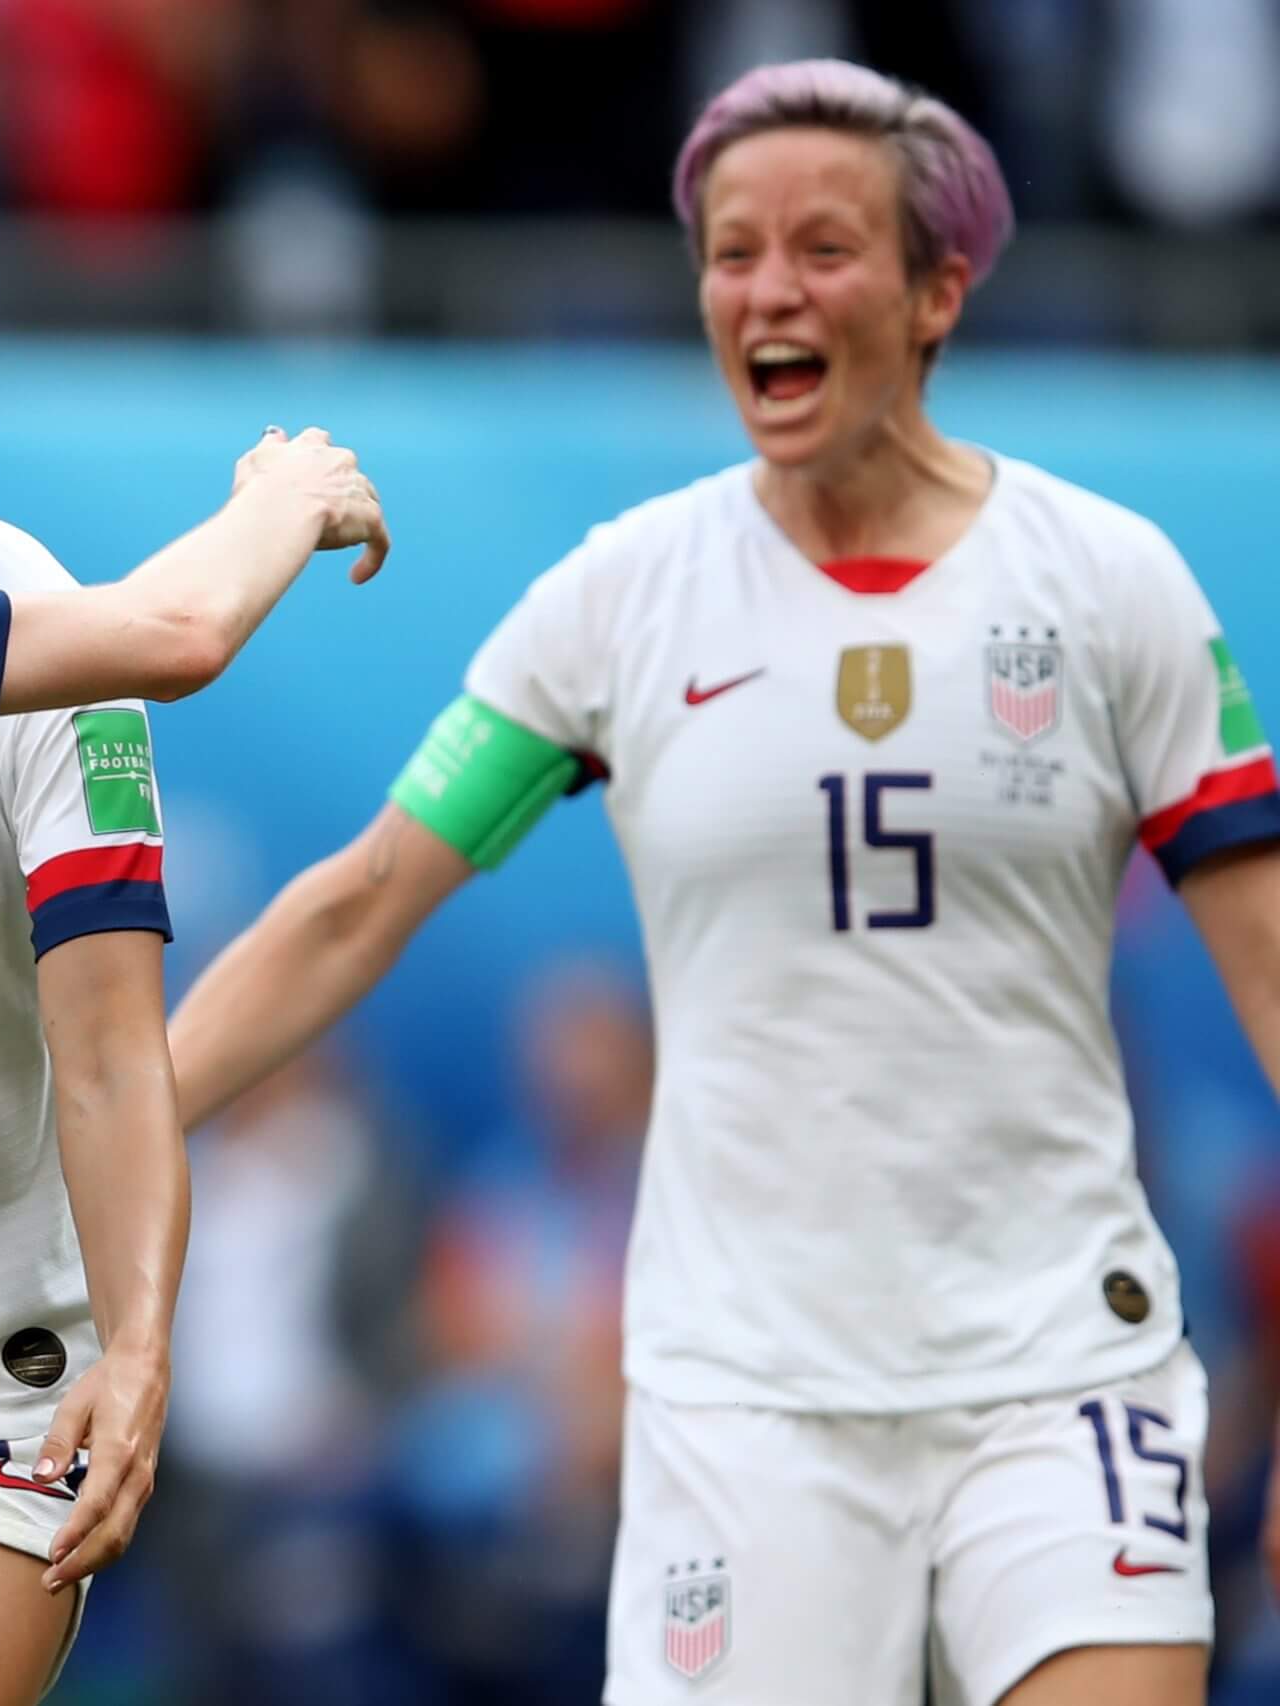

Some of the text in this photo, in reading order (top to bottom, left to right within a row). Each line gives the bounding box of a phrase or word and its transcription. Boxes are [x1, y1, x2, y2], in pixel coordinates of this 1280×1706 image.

[991, 653, 1054, 688] USA
[88, 756, 150, 771] FOOTBA
[818, 771, 936, 933] 15
[1079, 1400, 1189, 1542] 15
[669, 1583, 724, 1623] USA
